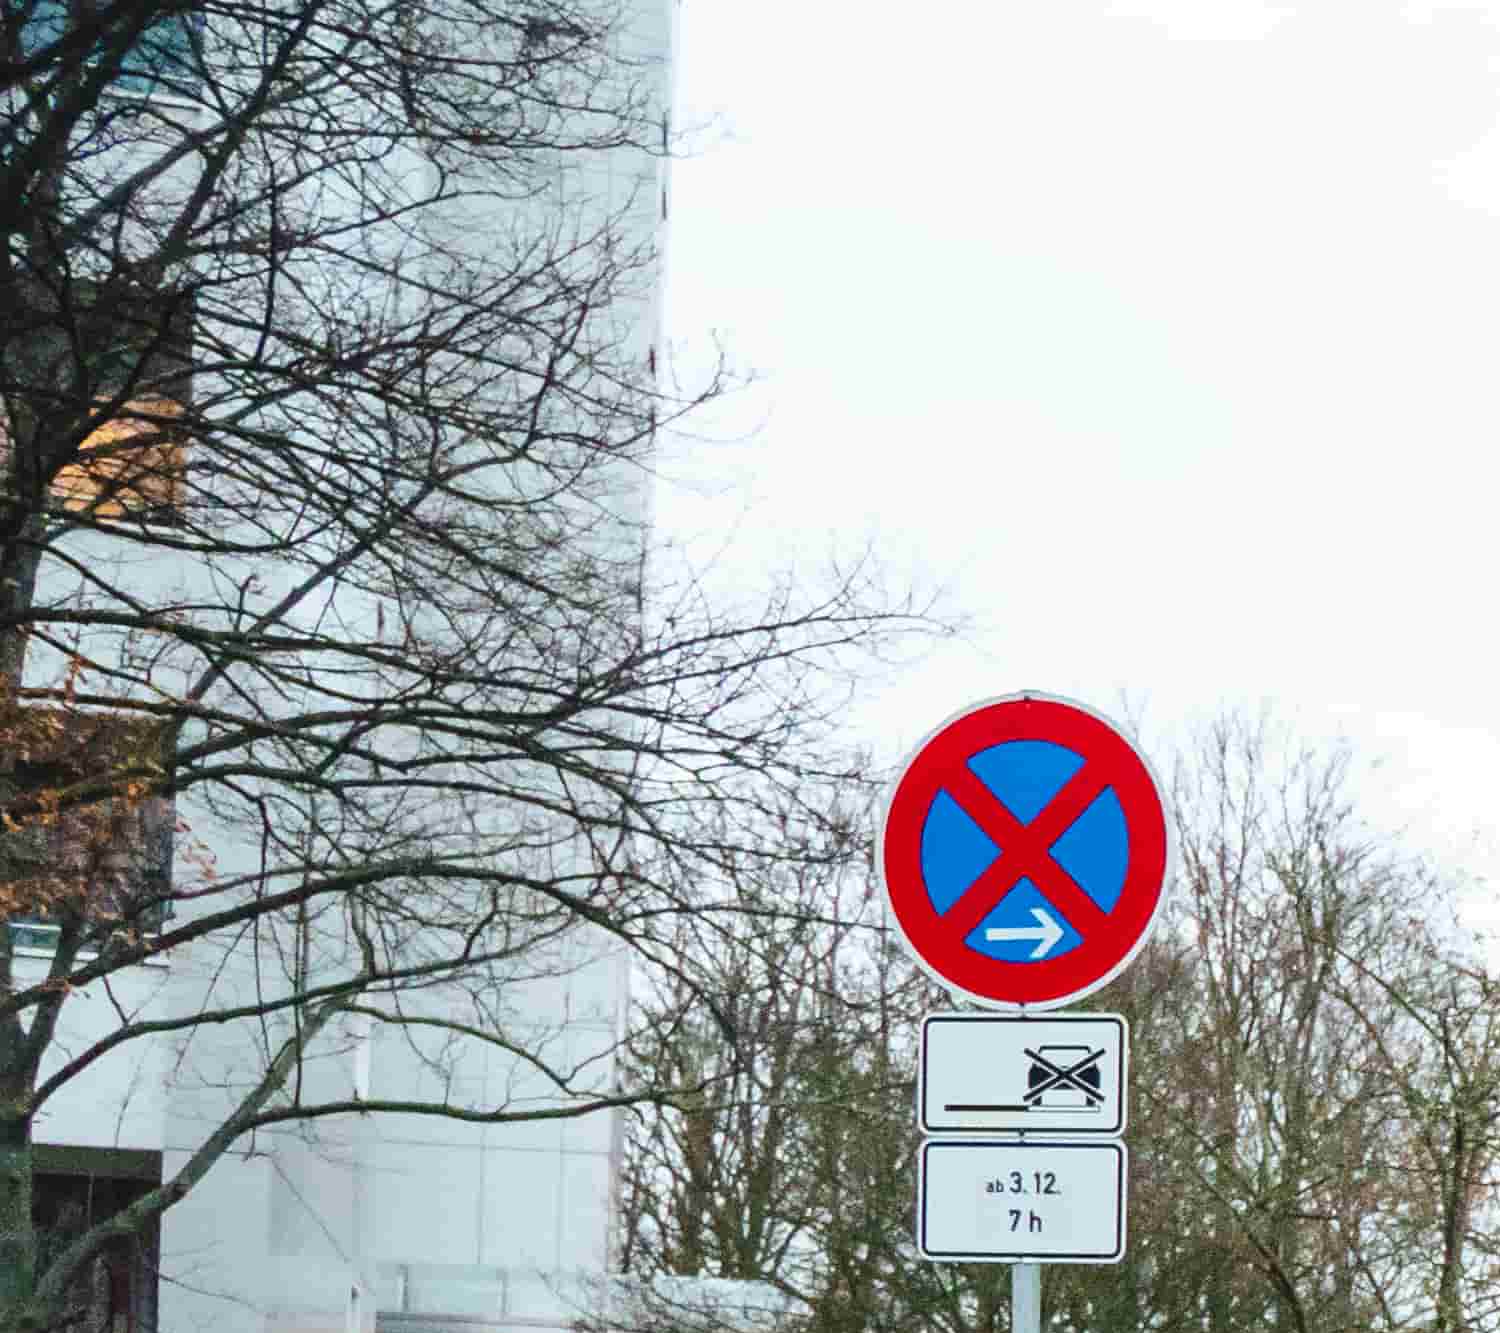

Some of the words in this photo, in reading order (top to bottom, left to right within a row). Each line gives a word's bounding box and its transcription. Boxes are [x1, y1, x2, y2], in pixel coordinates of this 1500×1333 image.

[986, 1178, 1004, 1193] ab
[1009, 1208, 1022, 1232] 7
[1029, 1208, 1043, 1232] h
